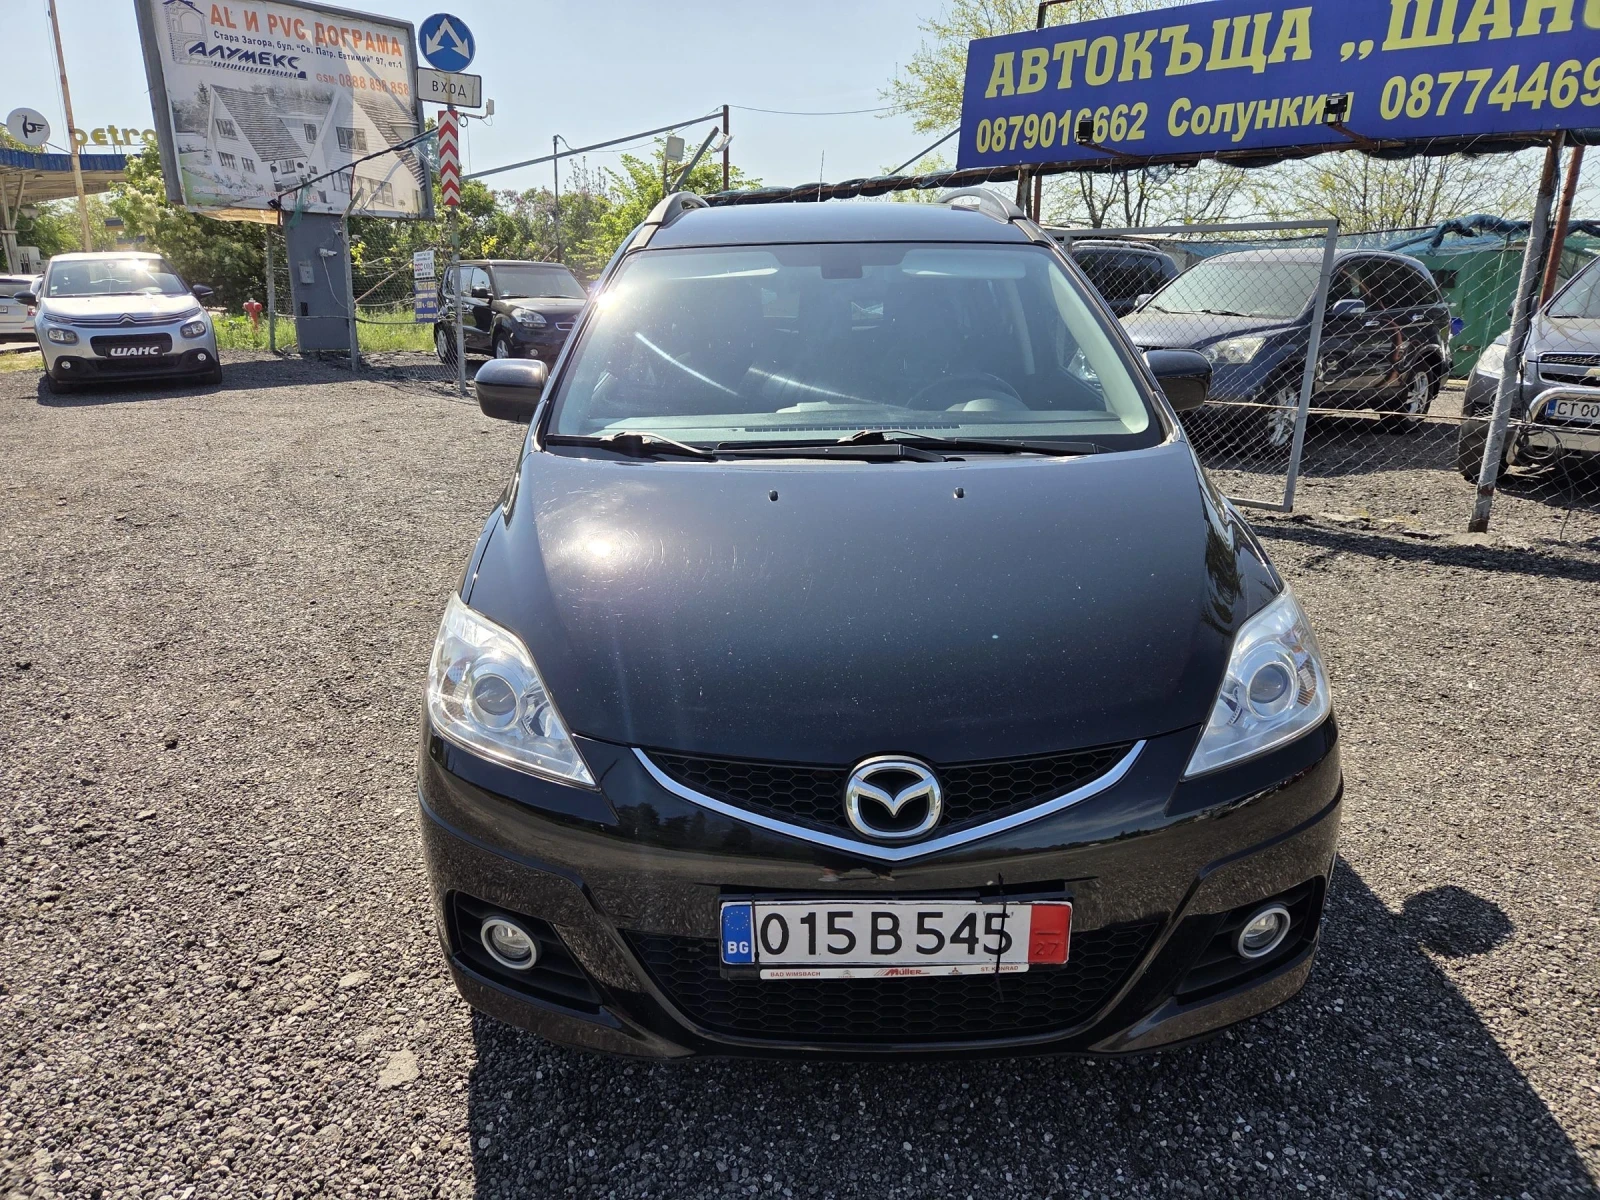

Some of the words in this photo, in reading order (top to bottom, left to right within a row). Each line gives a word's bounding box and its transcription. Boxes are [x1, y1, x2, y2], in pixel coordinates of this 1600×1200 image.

[211, 3, 237, 30] AL
[243, 9, 260, 33] И
[267, 13, 307, 41] PVC
[314, 21, 403, 57] ДОГРАМА
[213, 30, 240, 43] Стара
[242, 35, 275, 49] Загора,
[188, 41, 301, 70] АЛУМЕКС
[984, 6, 1313, 99] АВТОКЪЩА
[338, 73, 367, 89] 0888
[390, 81, 410, 96] 858
[432, 80, 467, 99] ВХОД
[110, 346, 159, 356] ШАНС
[727, 941, 749, 954] BG
